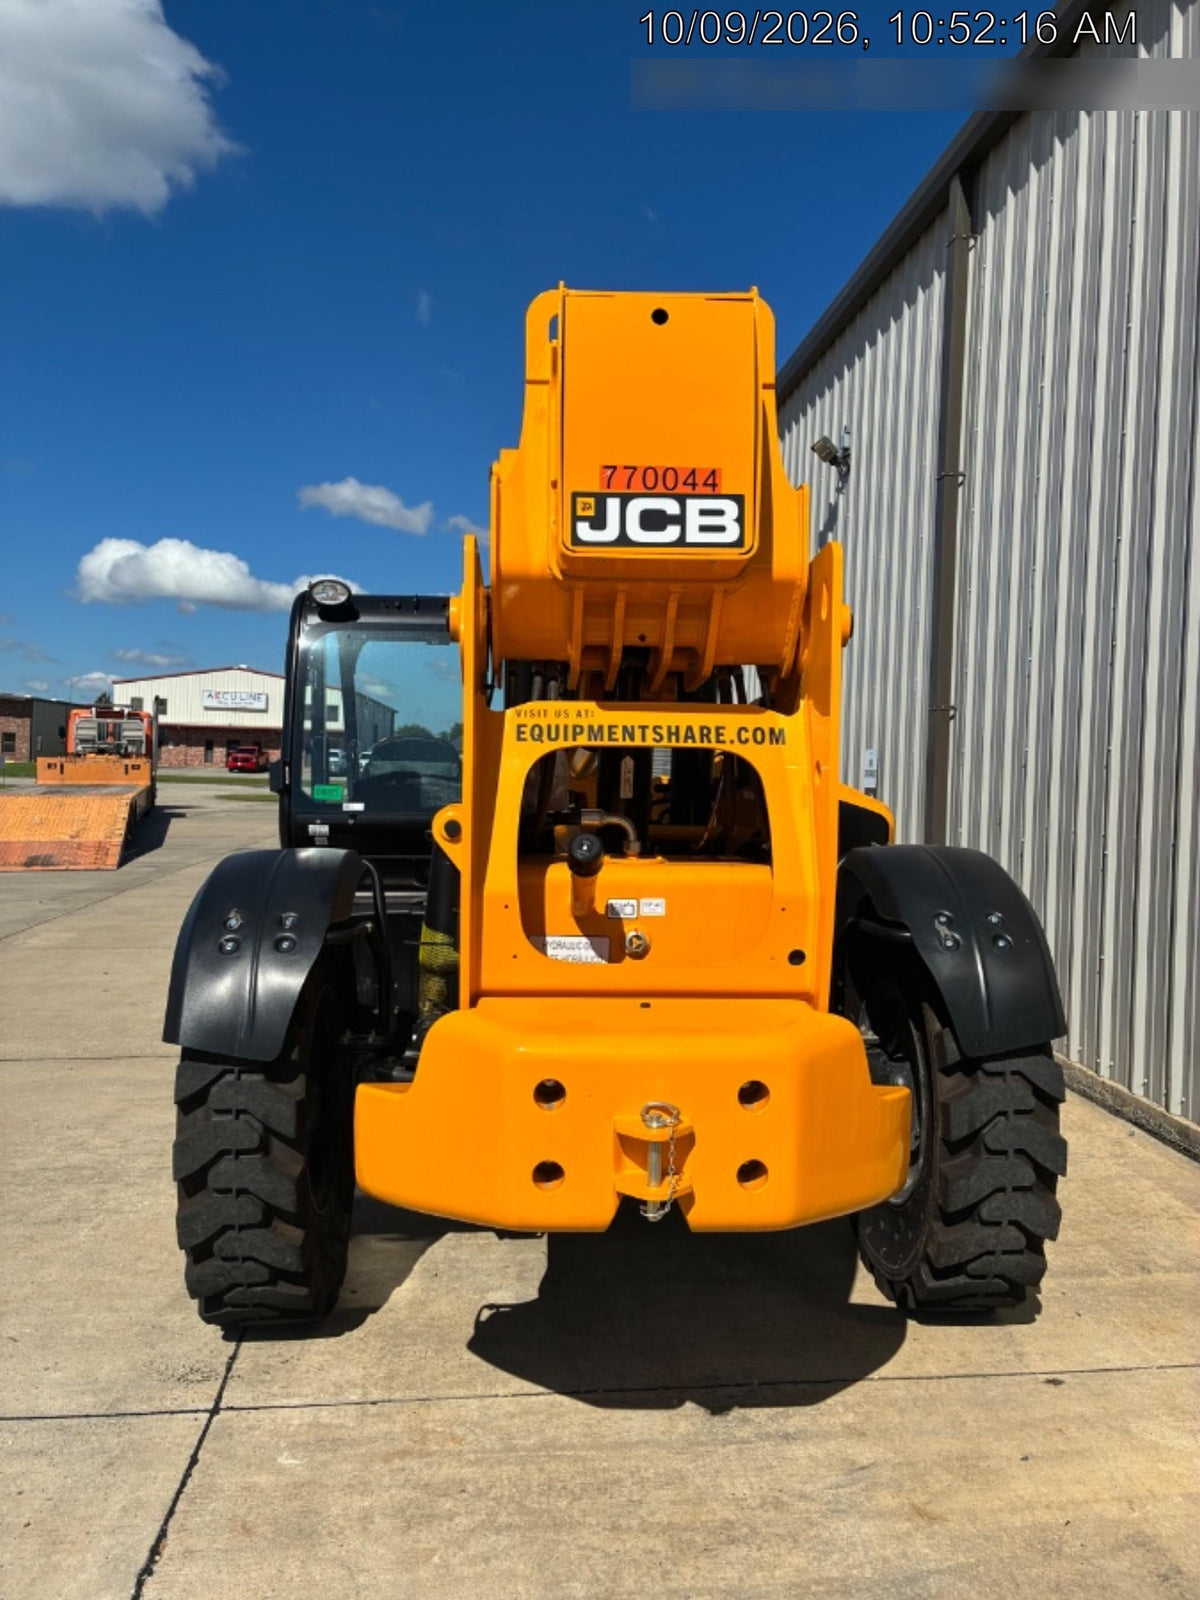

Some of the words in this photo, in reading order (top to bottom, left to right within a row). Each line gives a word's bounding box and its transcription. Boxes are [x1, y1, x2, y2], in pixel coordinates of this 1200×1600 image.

[602, 465, 719, 492] 770044
[576, 497, 741, 543] JCB
[515, 709, 549, 718] VISIT
[554, 709, 570, 718] US
[575, 709, 595, 718] AT:
[515, 724, 786, 745] EQUIPMENTSHARE.COM
